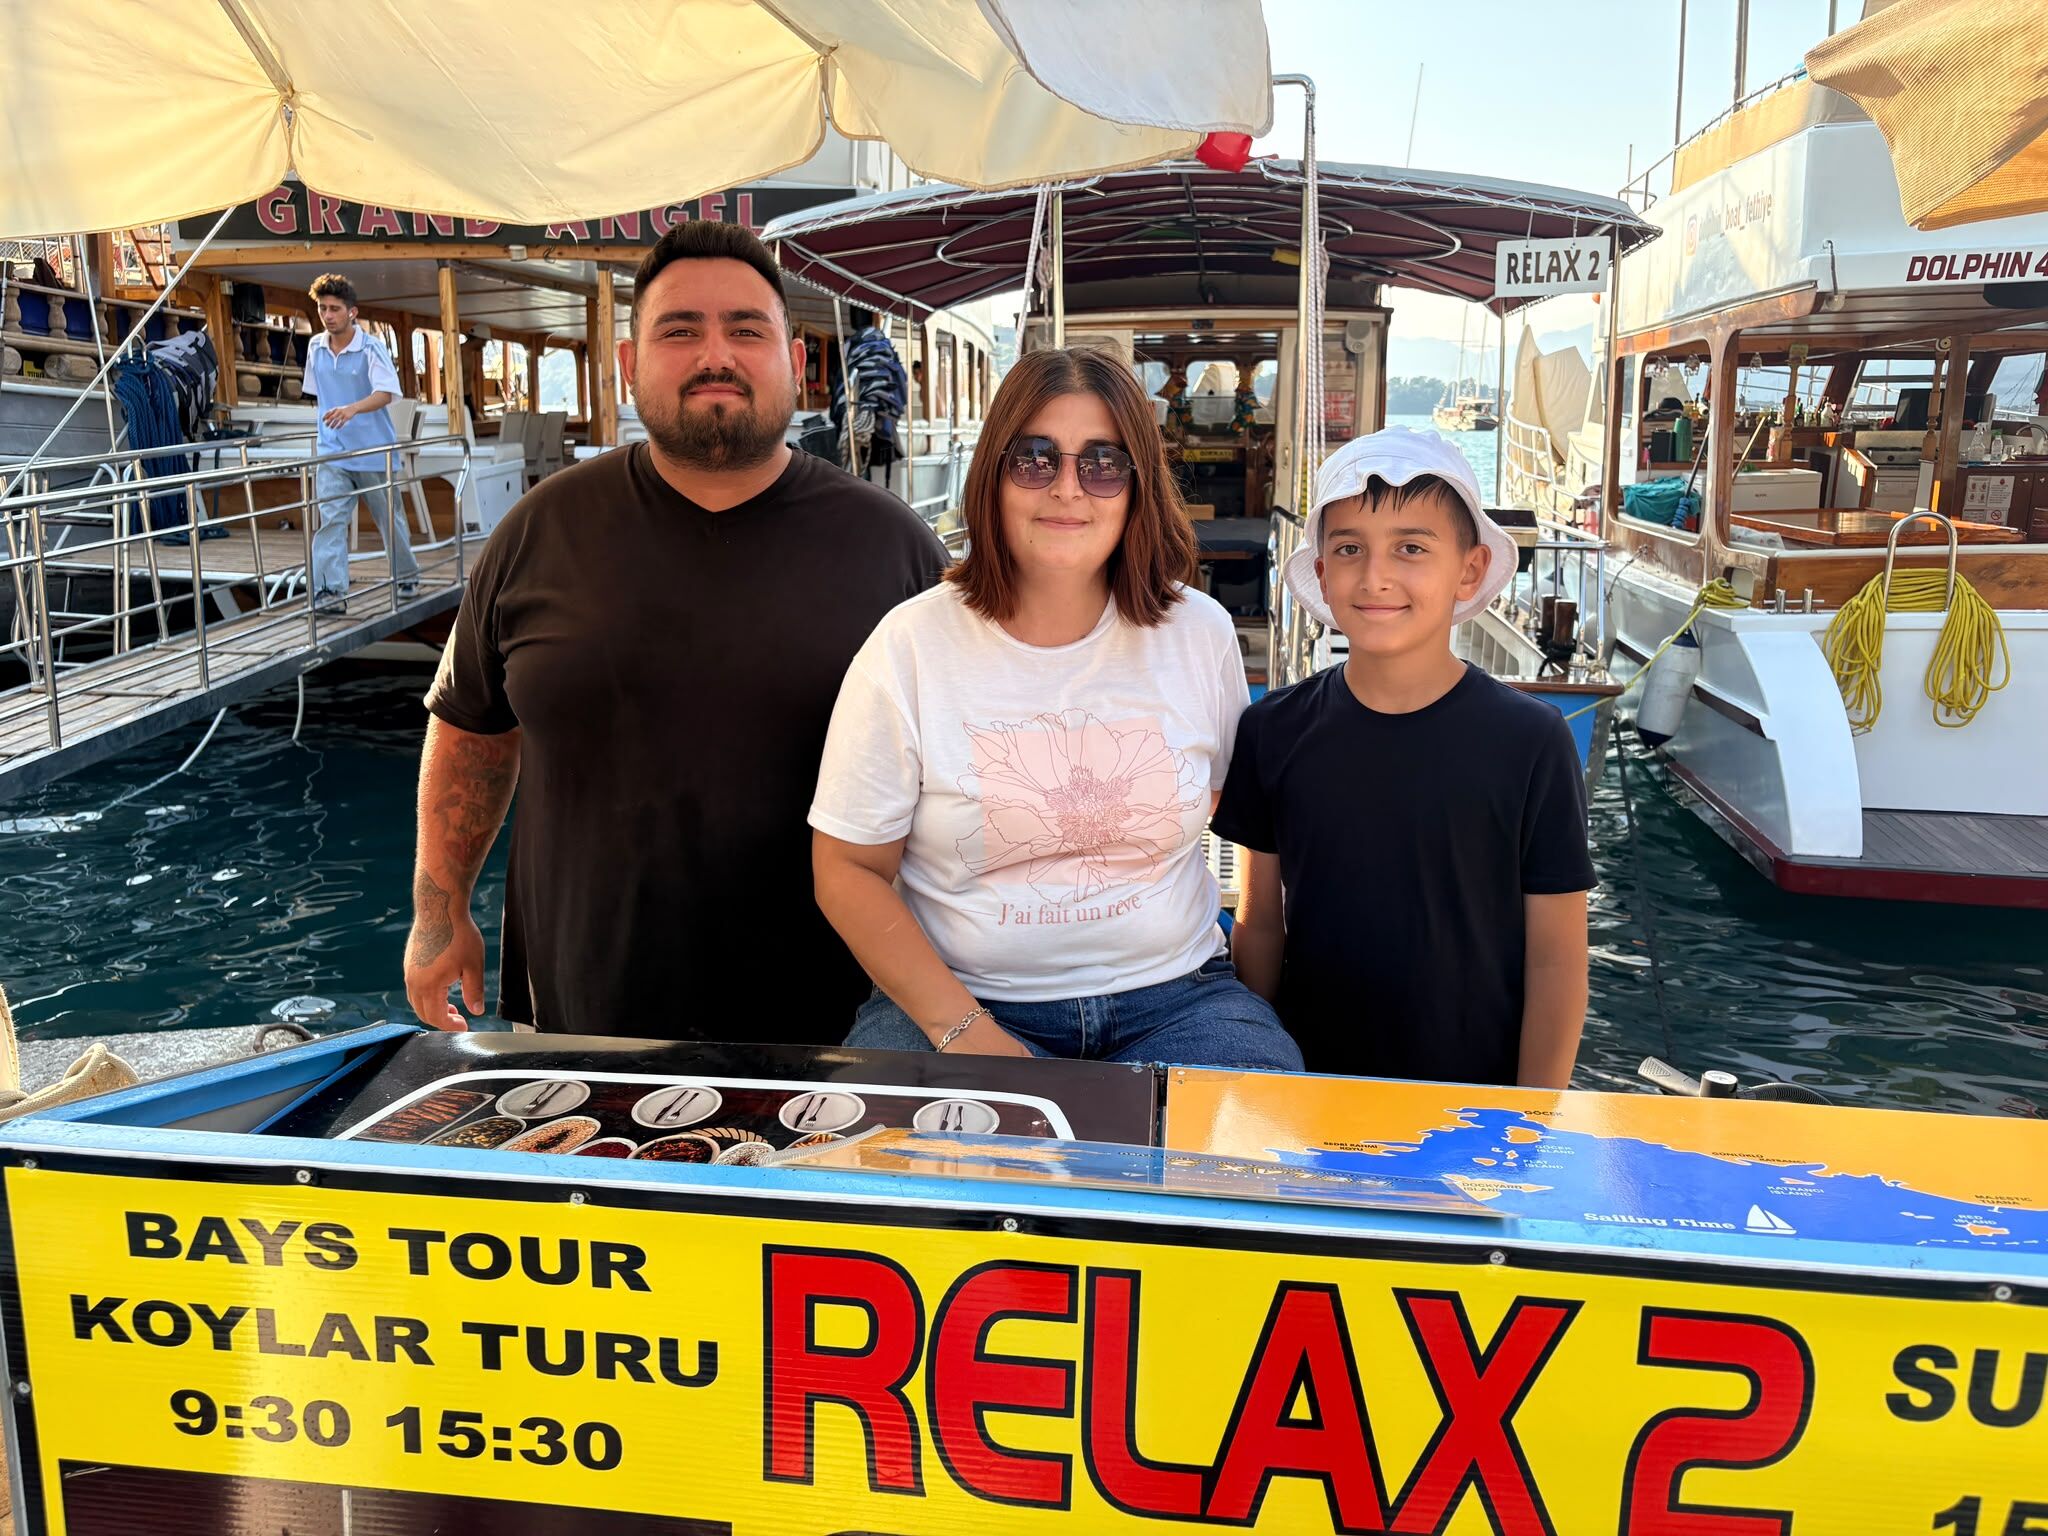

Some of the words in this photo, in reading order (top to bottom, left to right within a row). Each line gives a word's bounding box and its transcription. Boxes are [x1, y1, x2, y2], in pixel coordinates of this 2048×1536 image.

[1506, 249, 1581, 285] RELAX
[1587, 250, 1600, 281] 2
[1906, 251, 2033, 282] DOLPHIN
[1038, 904, 1071, 925] fait
[1076, 906, 1102, 922] un
[1462, 1182, 1522, 1190] DOCKYARD
[1583, 1211, 1669, 1227] Sailing
[1672, 1218, 1737, 1230] Time
[125, 1211, 358, 1271] BAYS
[388, 1227, 653, 1293] TOUR
[69, 1294, 436, 1366] KOYLAR
[461, 1321, 719, 1388] TURU
[762, 1243, 1583, 1536] RELAX
[1619, 1305, 1816, 1536] 2
[169, 1388, 351, 1448] 9:30
[385, 1405, 624, 1471] 15:30
